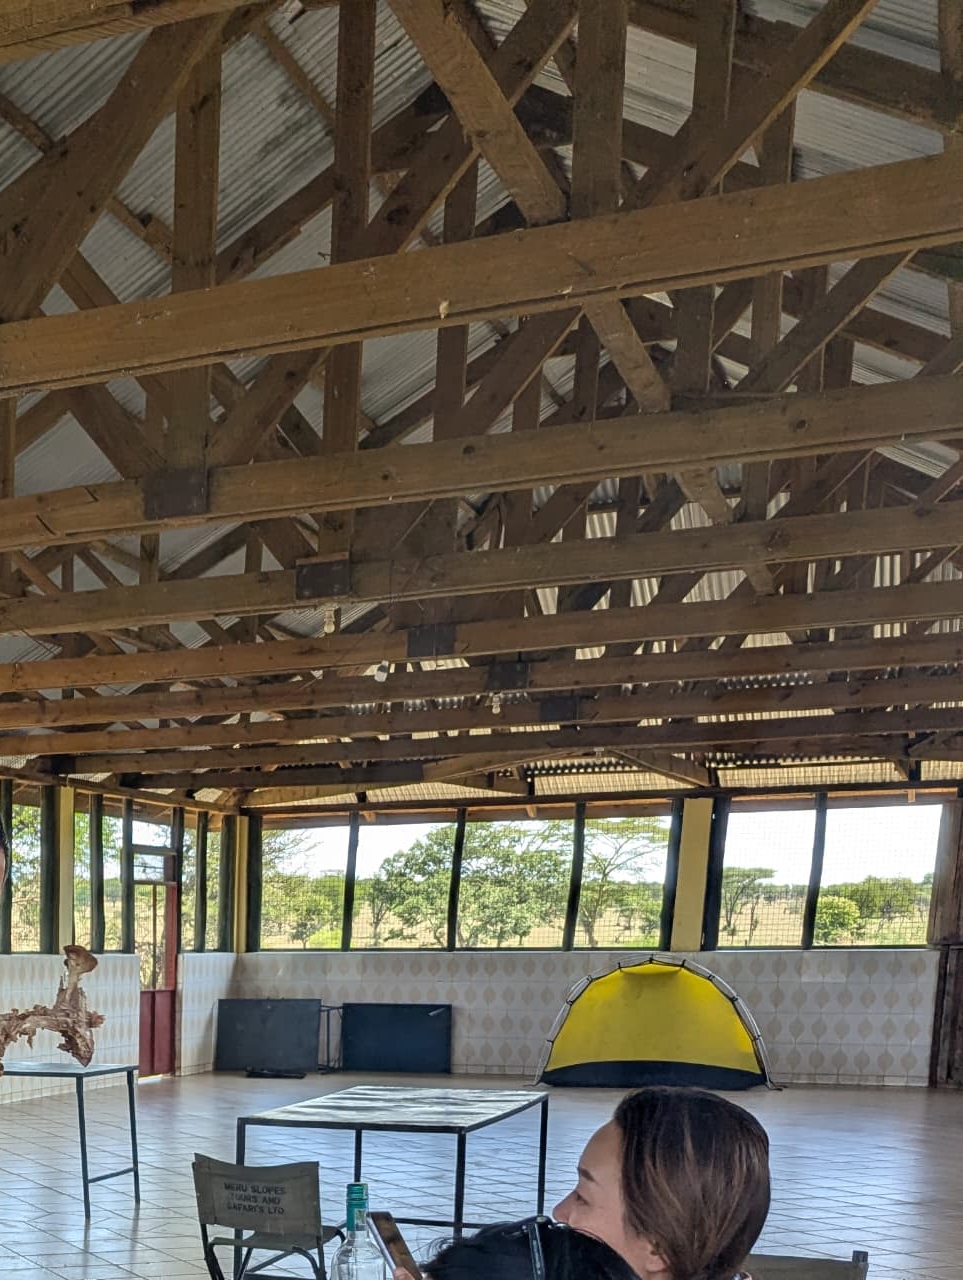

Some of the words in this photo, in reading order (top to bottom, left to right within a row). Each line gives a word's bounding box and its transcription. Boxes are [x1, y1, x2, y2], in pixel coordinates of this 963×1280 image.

[224, 1182, 247, 1193] MERU
[251, 1184, 285, 1195] SLOPES
[228, 1192, 257, 1204] TOURS
[262, 1196, 281, 1205] AND
[267, 1206, 285, 1215] LTD
